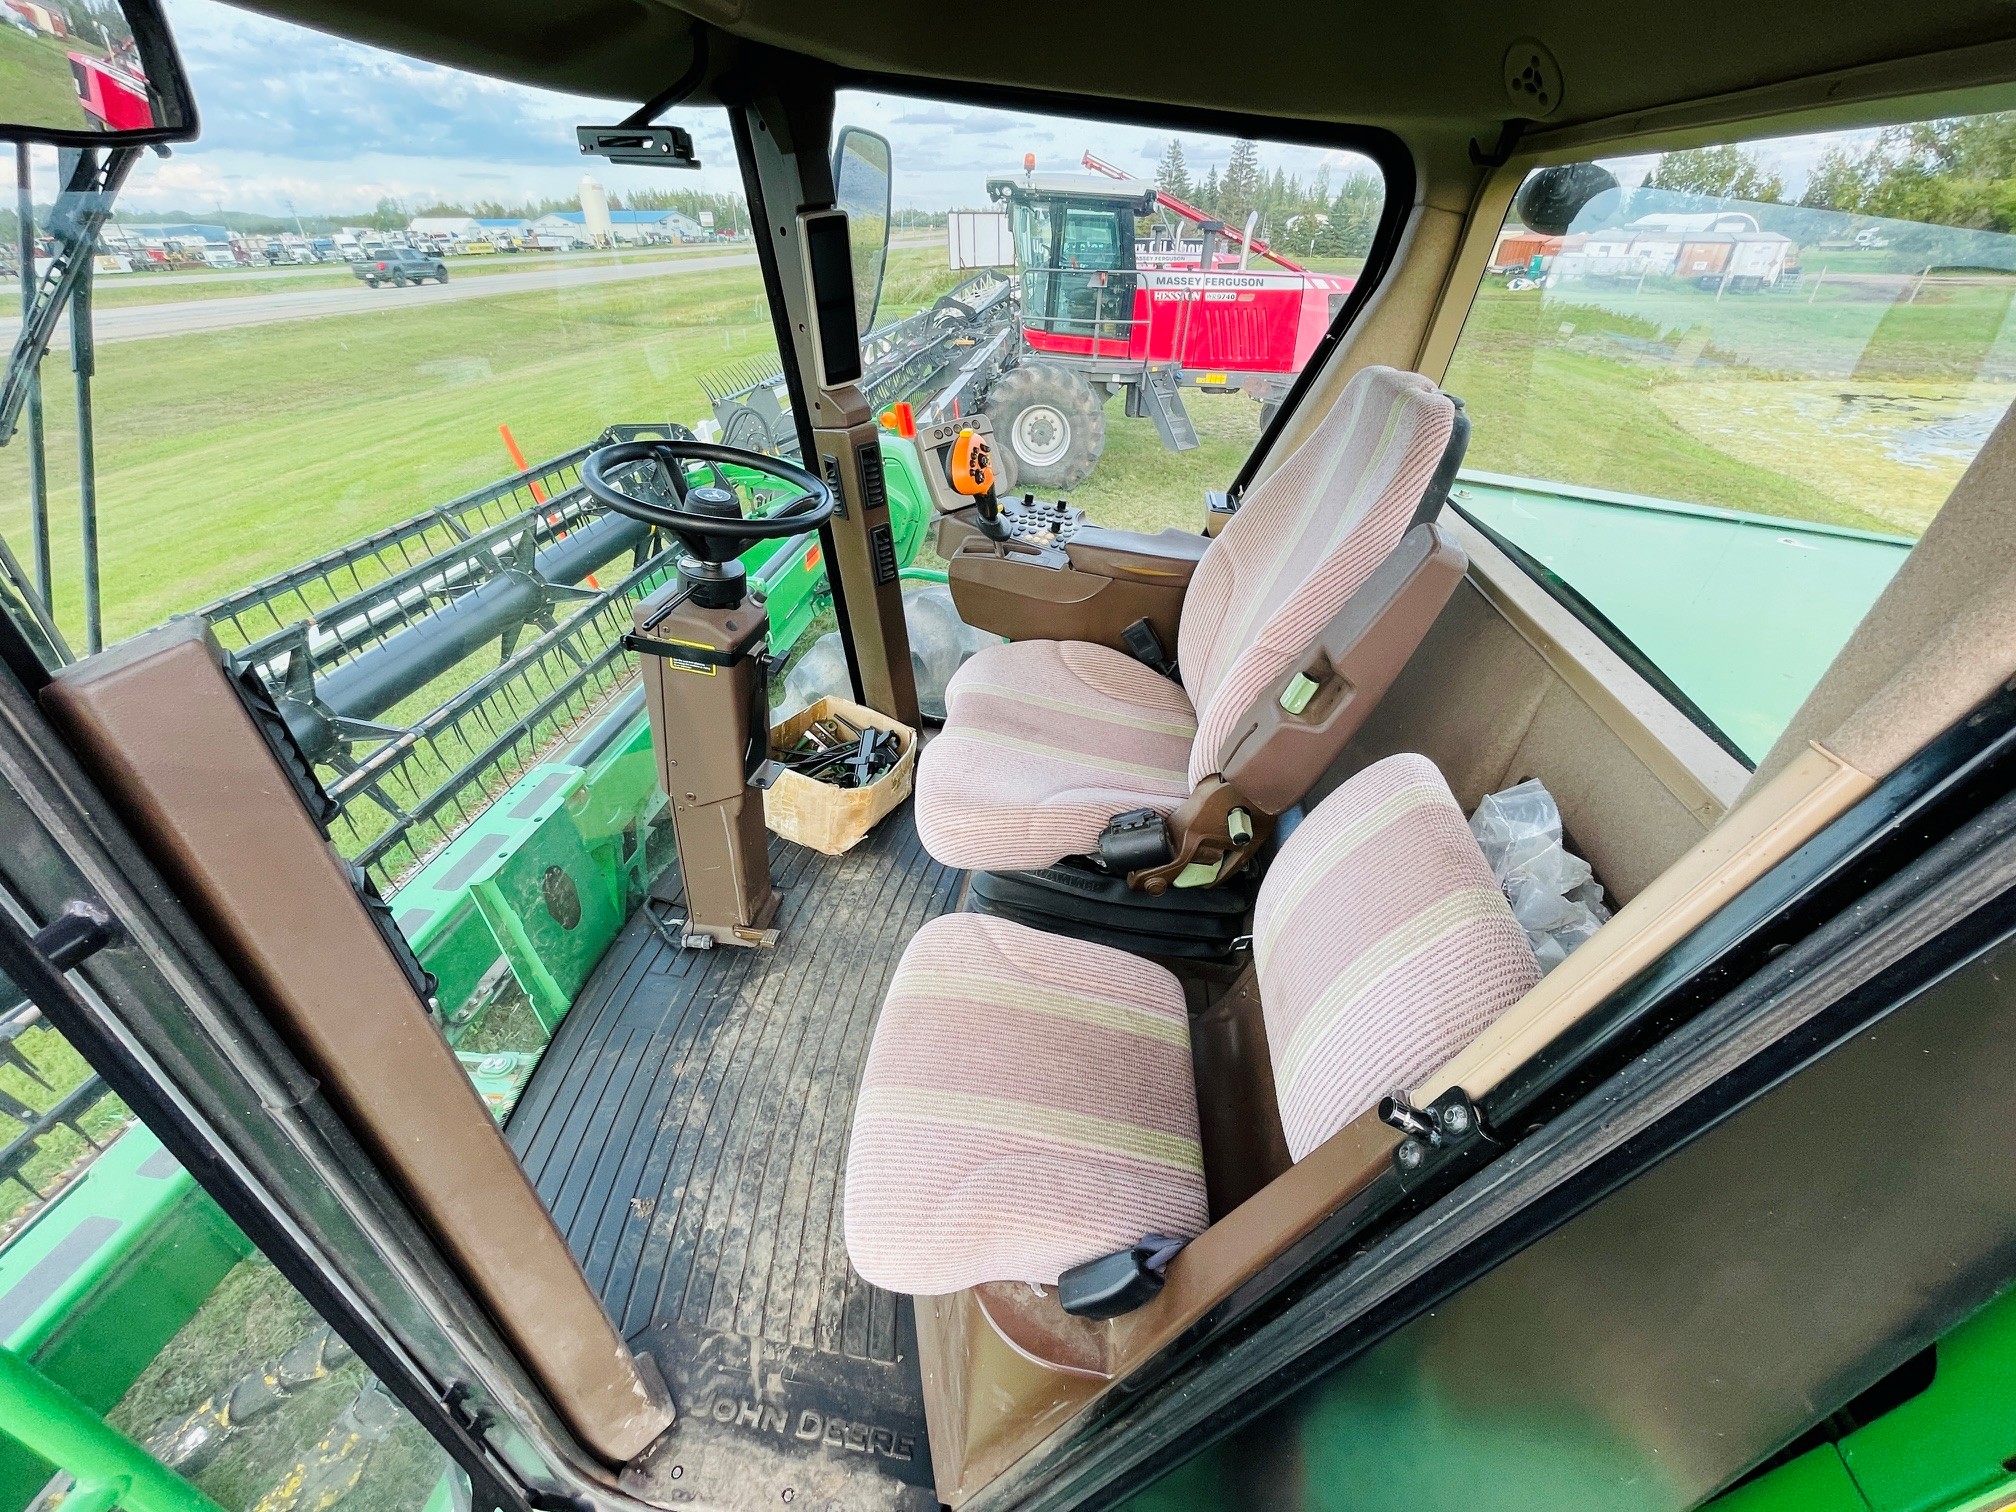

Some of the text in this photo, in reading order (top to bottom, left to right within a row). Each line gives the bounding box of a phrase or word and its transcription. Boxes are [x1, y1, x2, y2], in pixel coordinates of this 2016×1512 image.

[1156, 277, 1264, 287] MASSEY FERGUSON
[690, 1391, 915, 1461] JOHN DEERE
